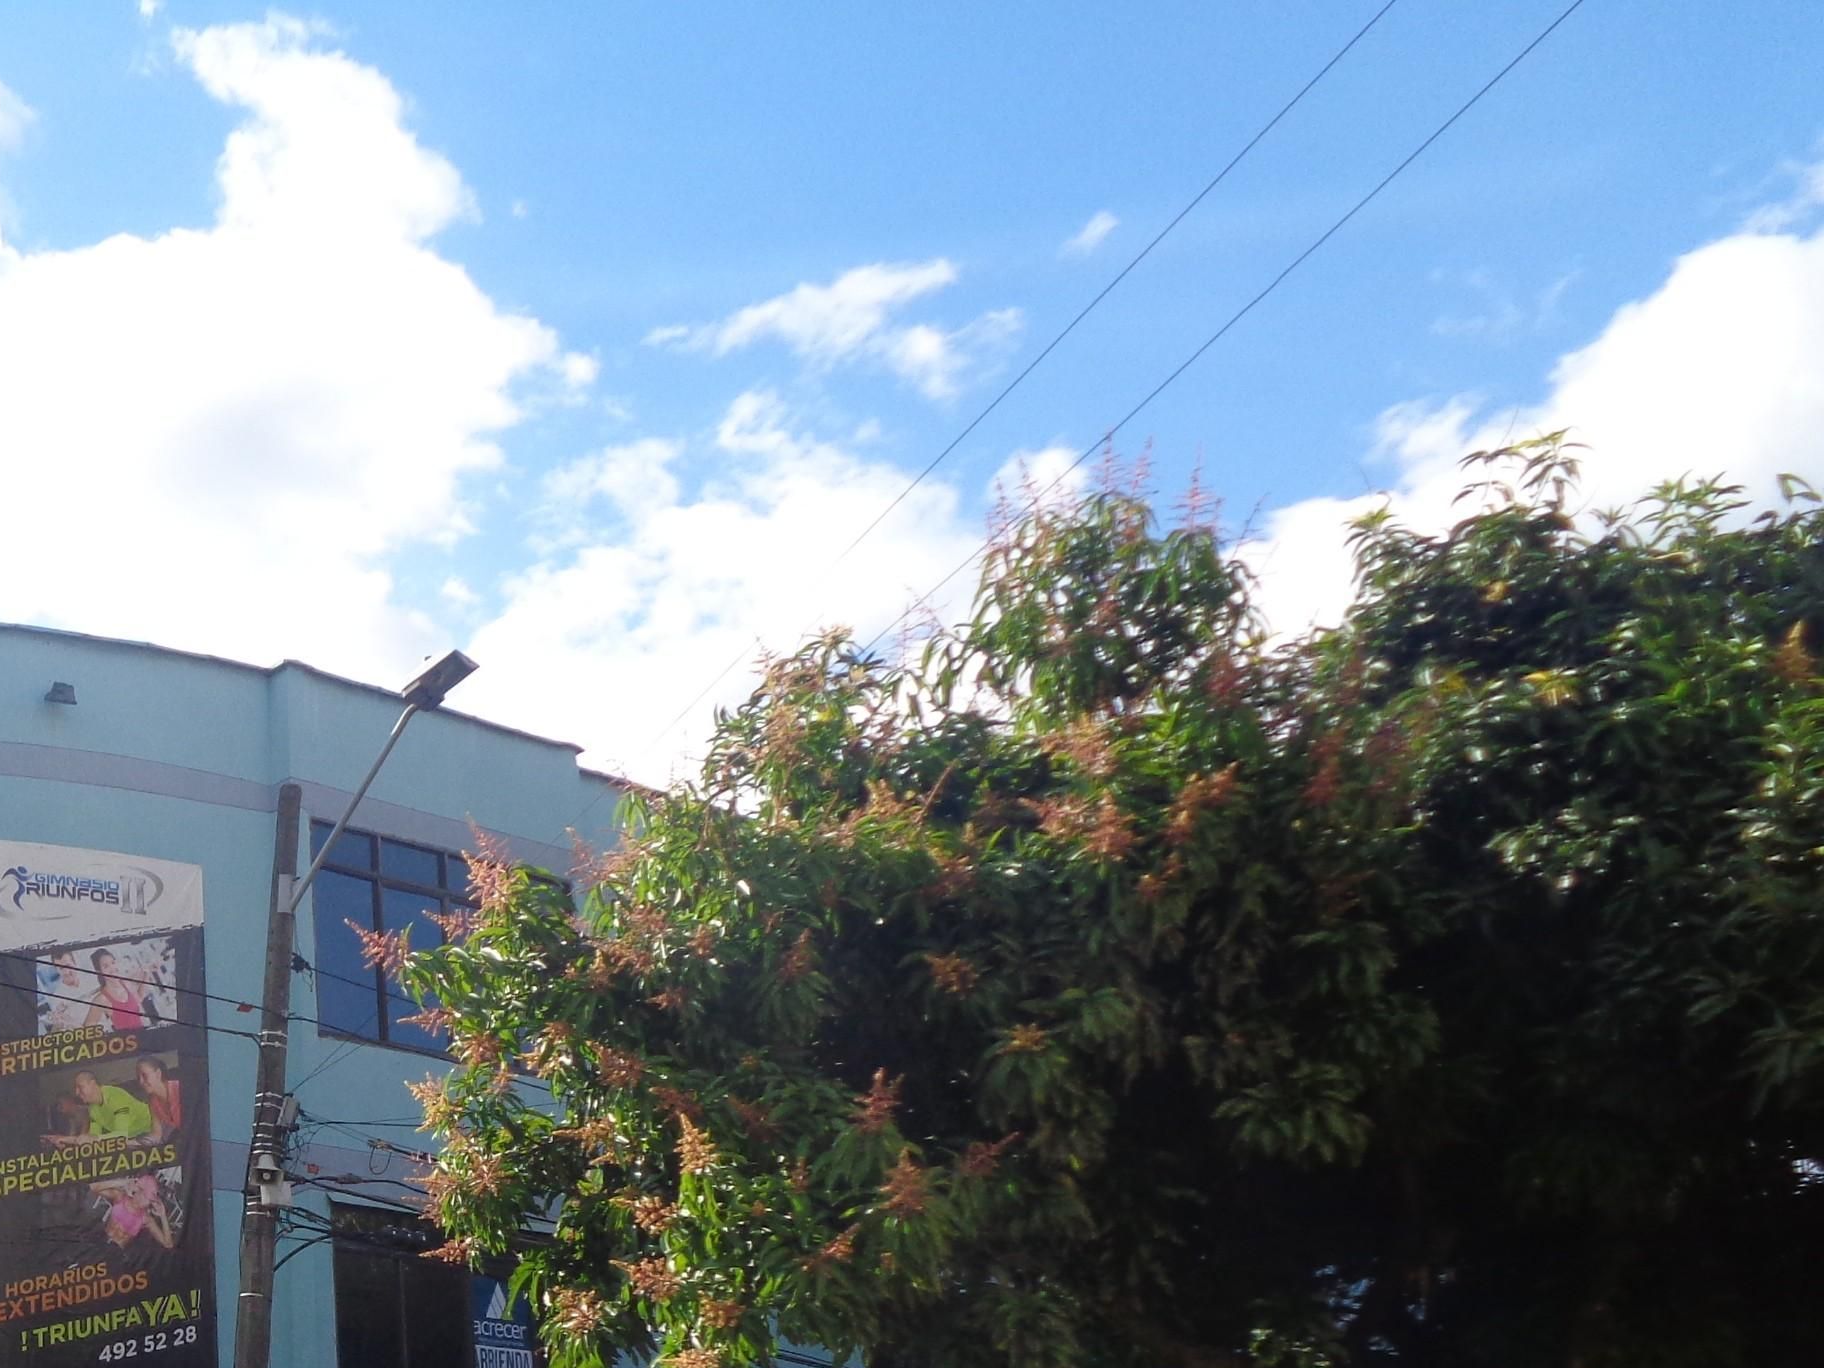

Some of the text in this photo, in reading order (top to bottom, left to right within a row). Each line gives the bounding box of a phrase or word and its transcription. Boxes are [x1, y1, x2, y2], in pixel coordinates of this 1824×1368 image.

[5, 1262, 108, 1298] HORARIOS
[98, 1326, 197, 1363] 492 52 28
[474, 1320, 527, 1339] acrecer
